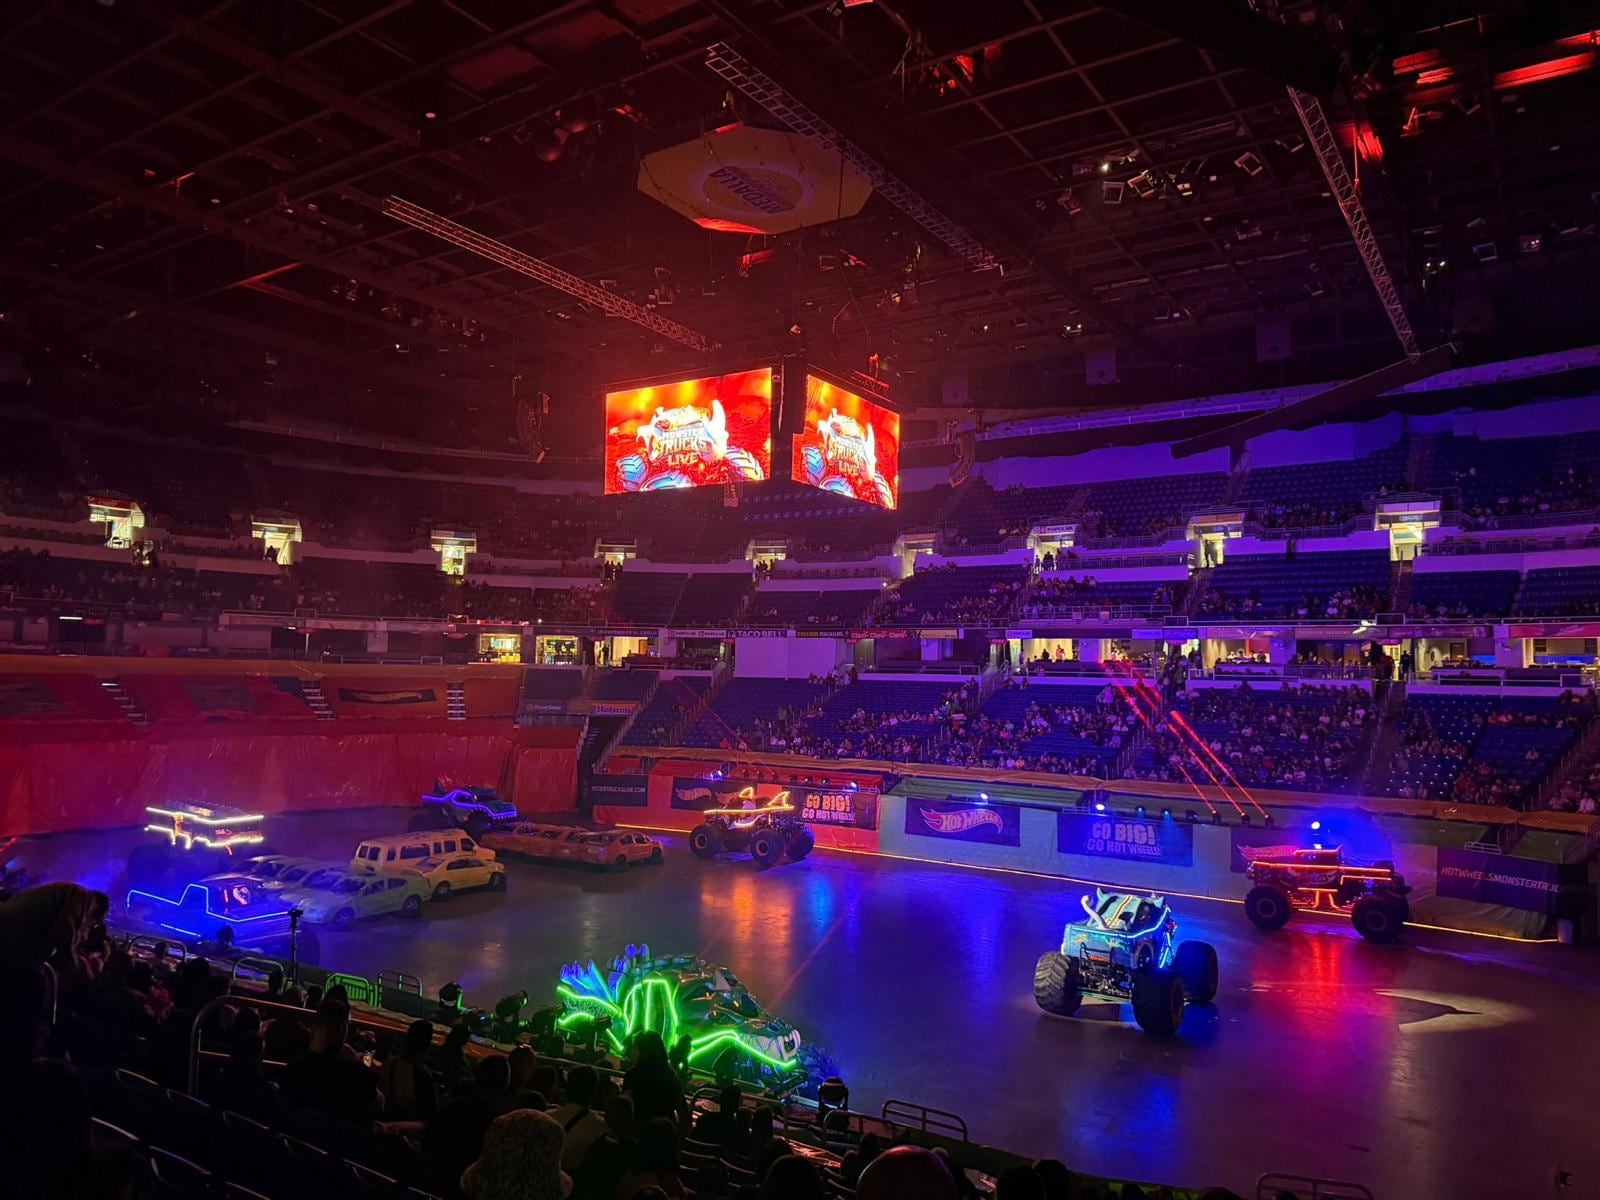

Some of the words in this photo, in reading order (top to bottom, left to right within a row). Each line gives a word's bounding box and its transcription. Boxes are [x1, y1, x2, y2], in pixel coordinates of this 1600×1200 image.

[709, 167, 787, 214] MEDALLA
[656, 438, 707, 454] TRUCKS
[668, 453, 699, 466] LIVE
[838, 460, 859, 475] LIVE
[807, 794, 820, 809] GO
[822, 795, 850, 812] BIG!
[802, 808, 815, 819] GO
[816, 809, 830, 819] HOT
[942, 814, 962, 831] HOT
[1092, 822, 1111, 840] GO
[1115, 823, 1156, 845] BIG!
[1087, 838, 1104, 852] GO
[1106, 840, 1126, 853] HOT
[1127, 843, 1162, 856] WHEELS
